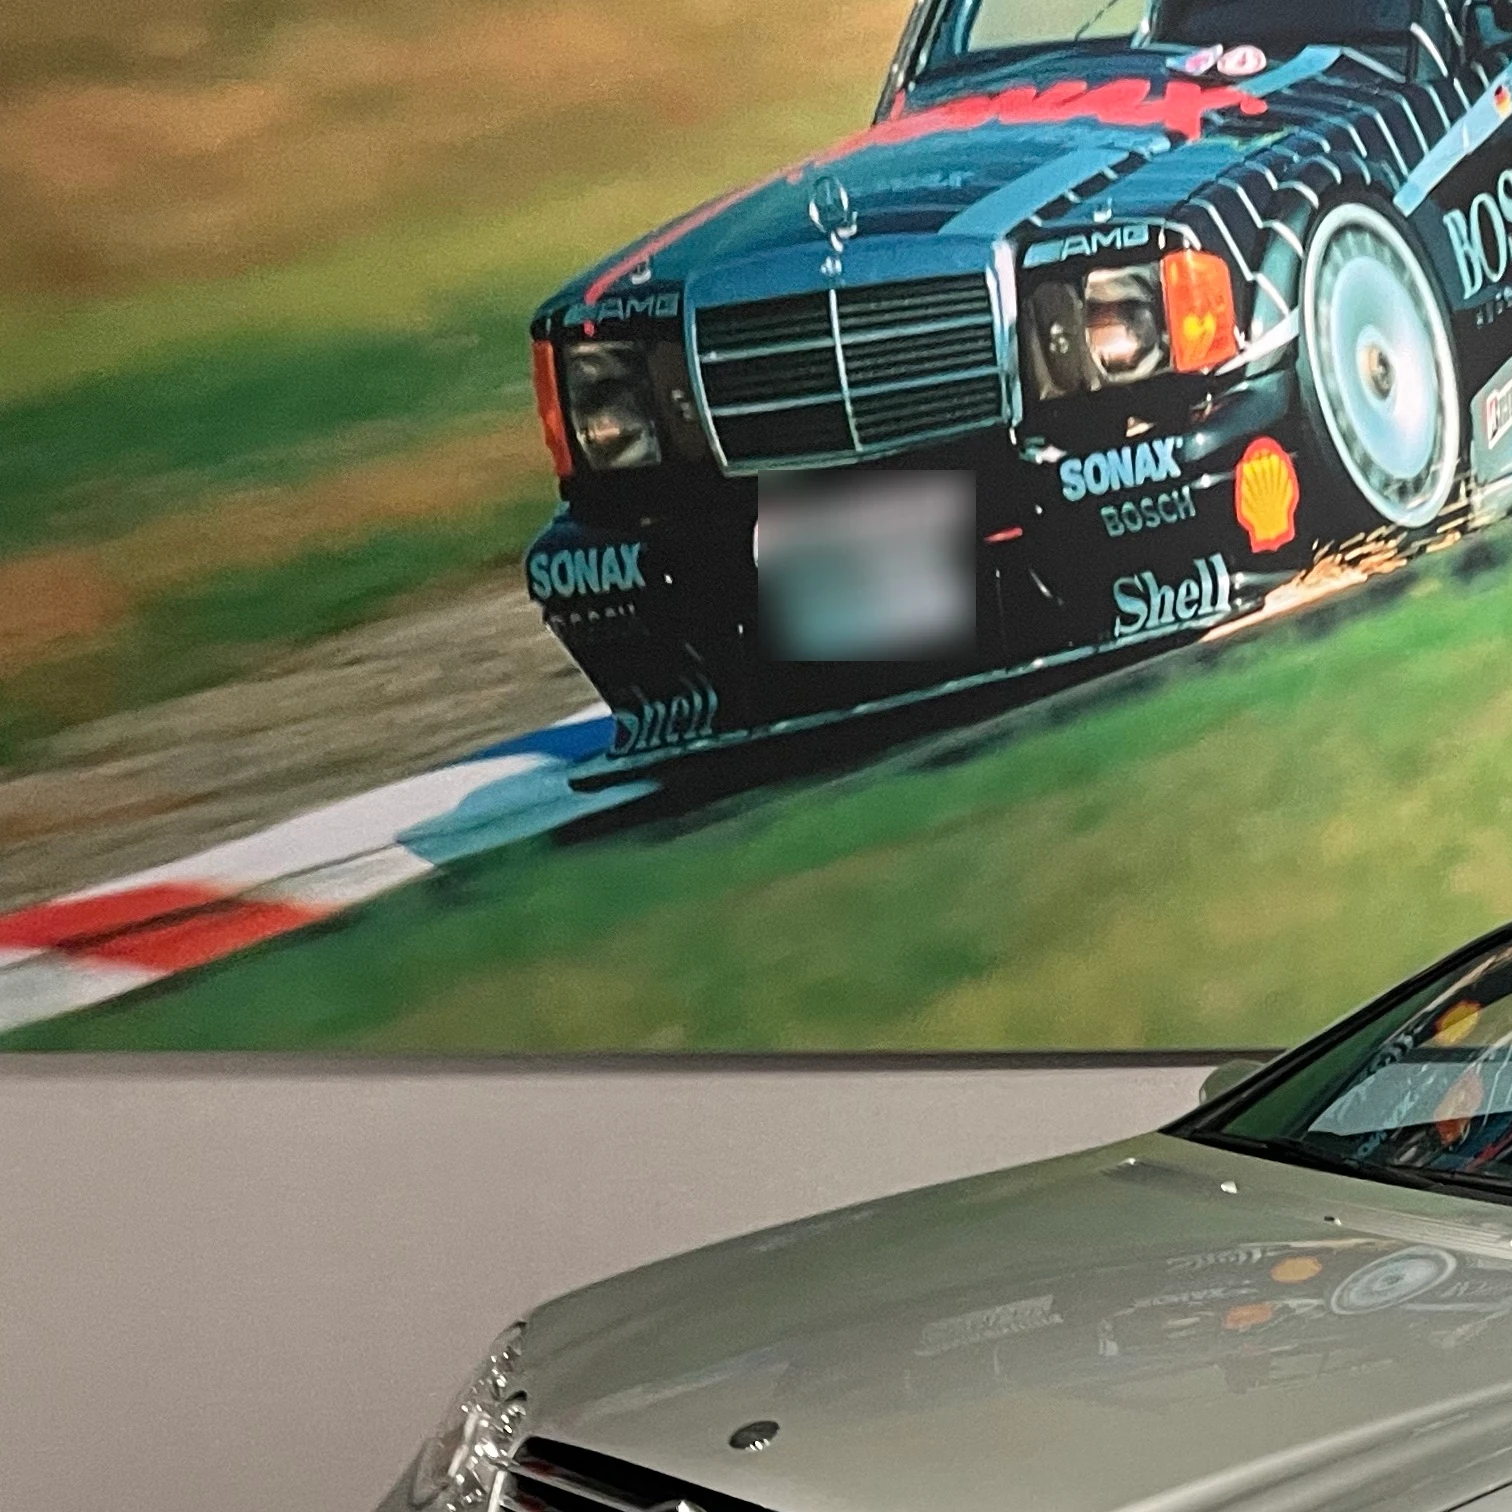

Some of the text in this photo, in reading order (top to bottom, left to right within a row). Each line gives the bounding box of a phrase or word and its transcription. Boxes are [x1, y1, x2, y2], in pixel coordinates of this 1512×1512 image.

[1060, 436, 1183, 500] SONAX
[1101, 485, 1197, 538] BOSCH
[530, 541, 646, 600] SONAX
[1113, 553, 1231, 639] Shell
